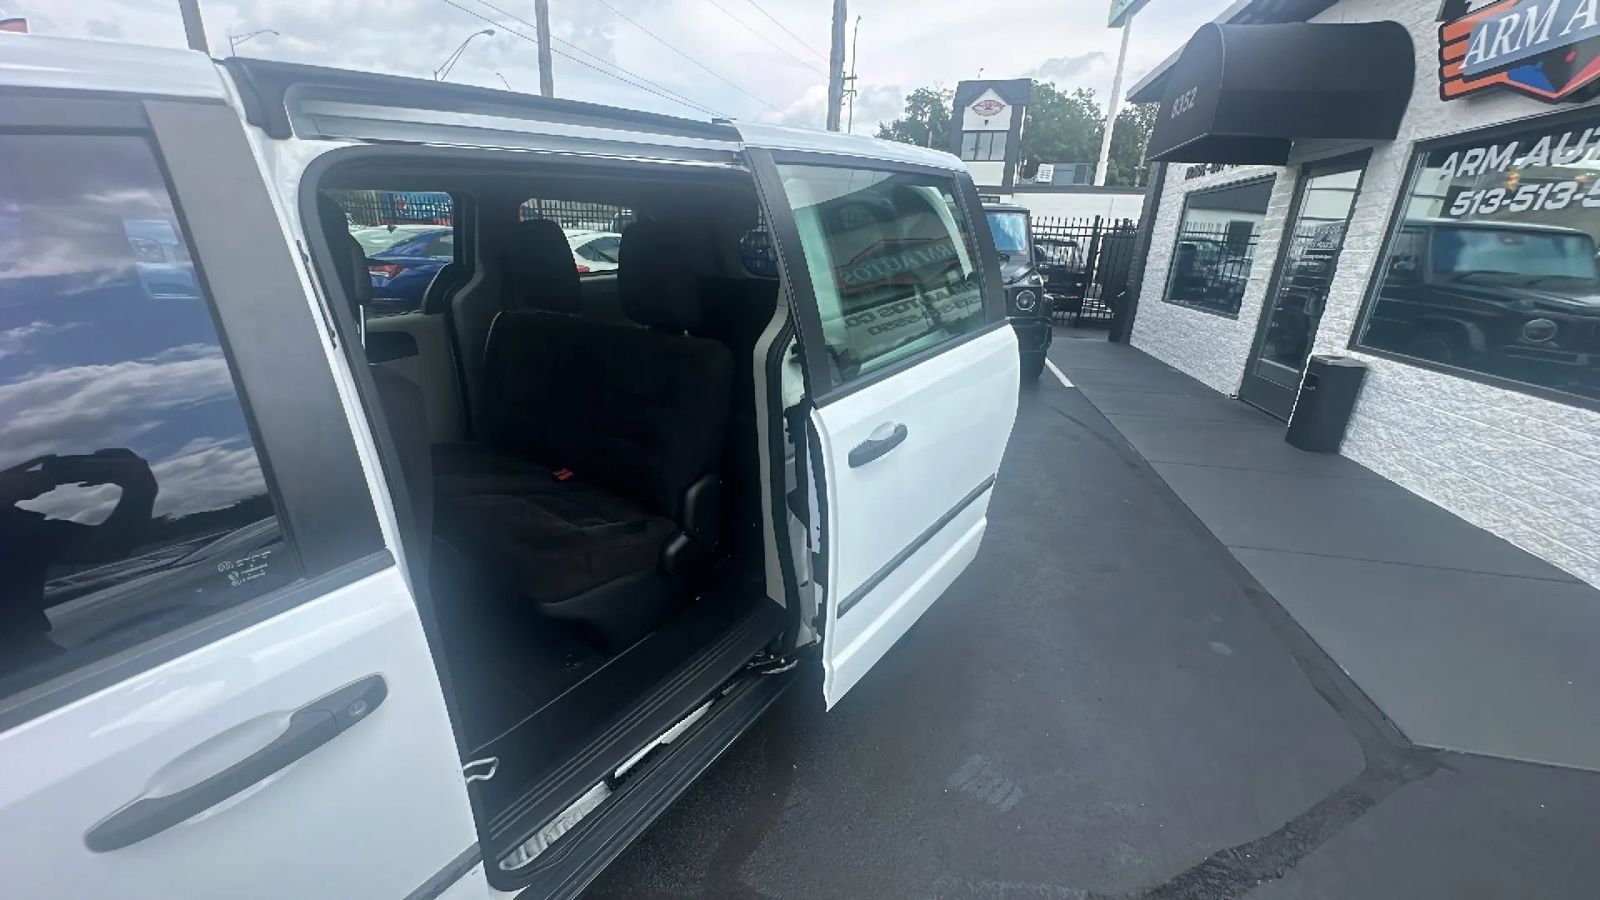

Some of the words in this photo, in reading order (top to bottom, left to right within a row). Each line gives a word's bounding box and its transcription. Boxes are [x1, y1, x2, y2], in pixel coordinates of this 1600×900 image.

[1458, 0, 1560, 70] ARM
[1171, 86, 1198, 119] 8352
[1439, 141, 1519, 181] ARM
